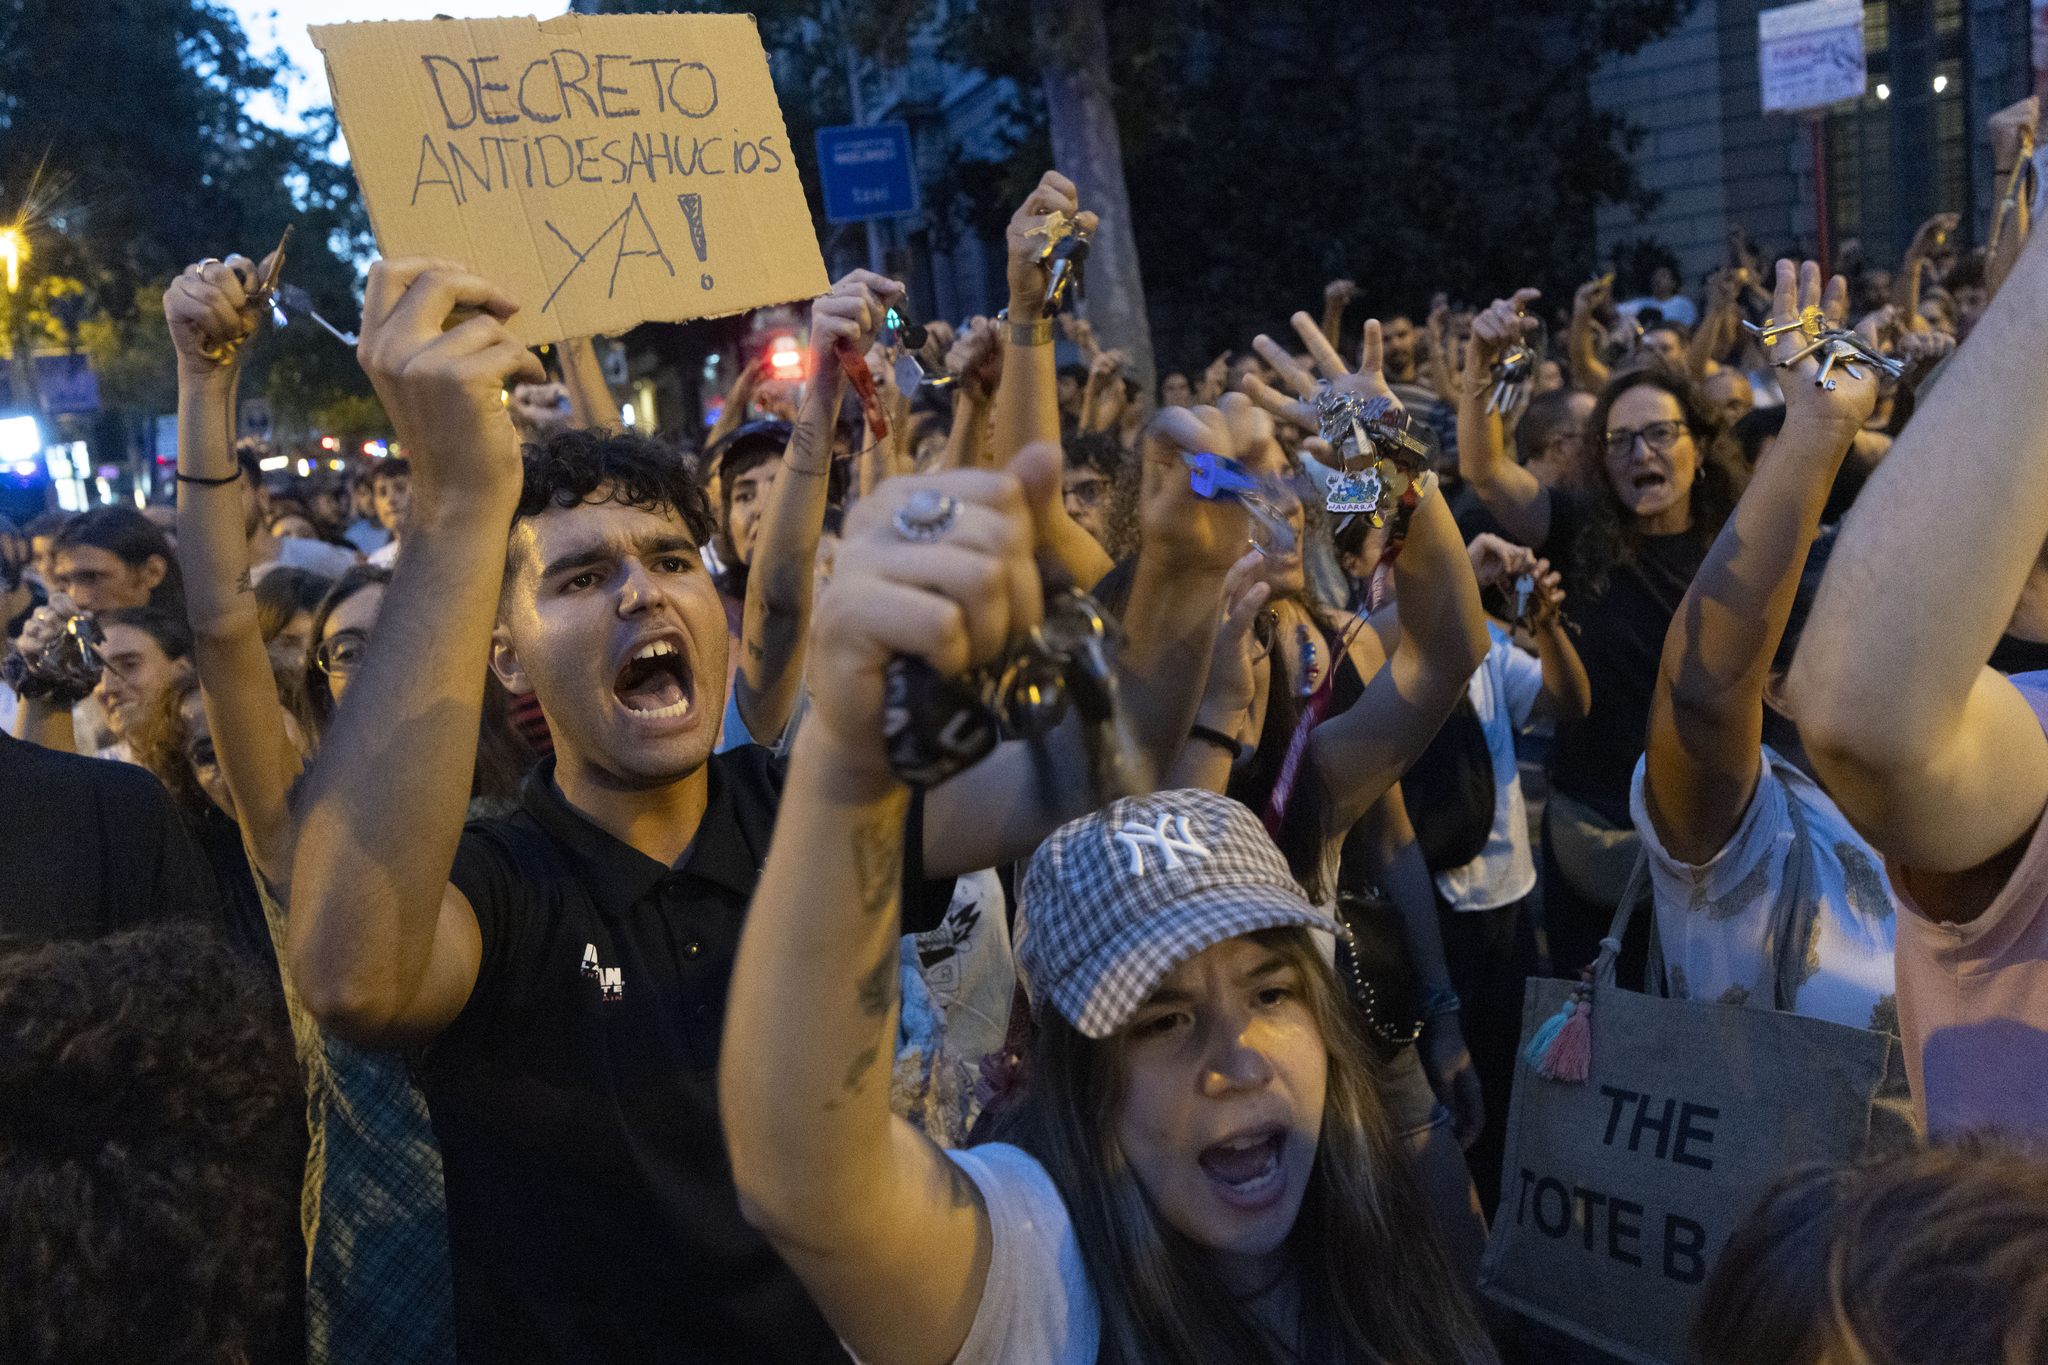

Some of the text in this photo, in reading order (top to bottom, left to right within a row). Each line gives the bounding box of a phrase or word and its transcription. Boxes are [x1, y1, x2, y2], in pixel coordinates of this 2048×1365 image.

[420, 48, 719, 131] DECRETO
[541, 191, 714, 313] YA!
[1327, 502, 1375, 511] NAVARRA
[1114, 812, 1212, 876] NY
[1600, 1084, 1720, 1171] THE
[1516, 1167, 1706, 1286] TOTE B
